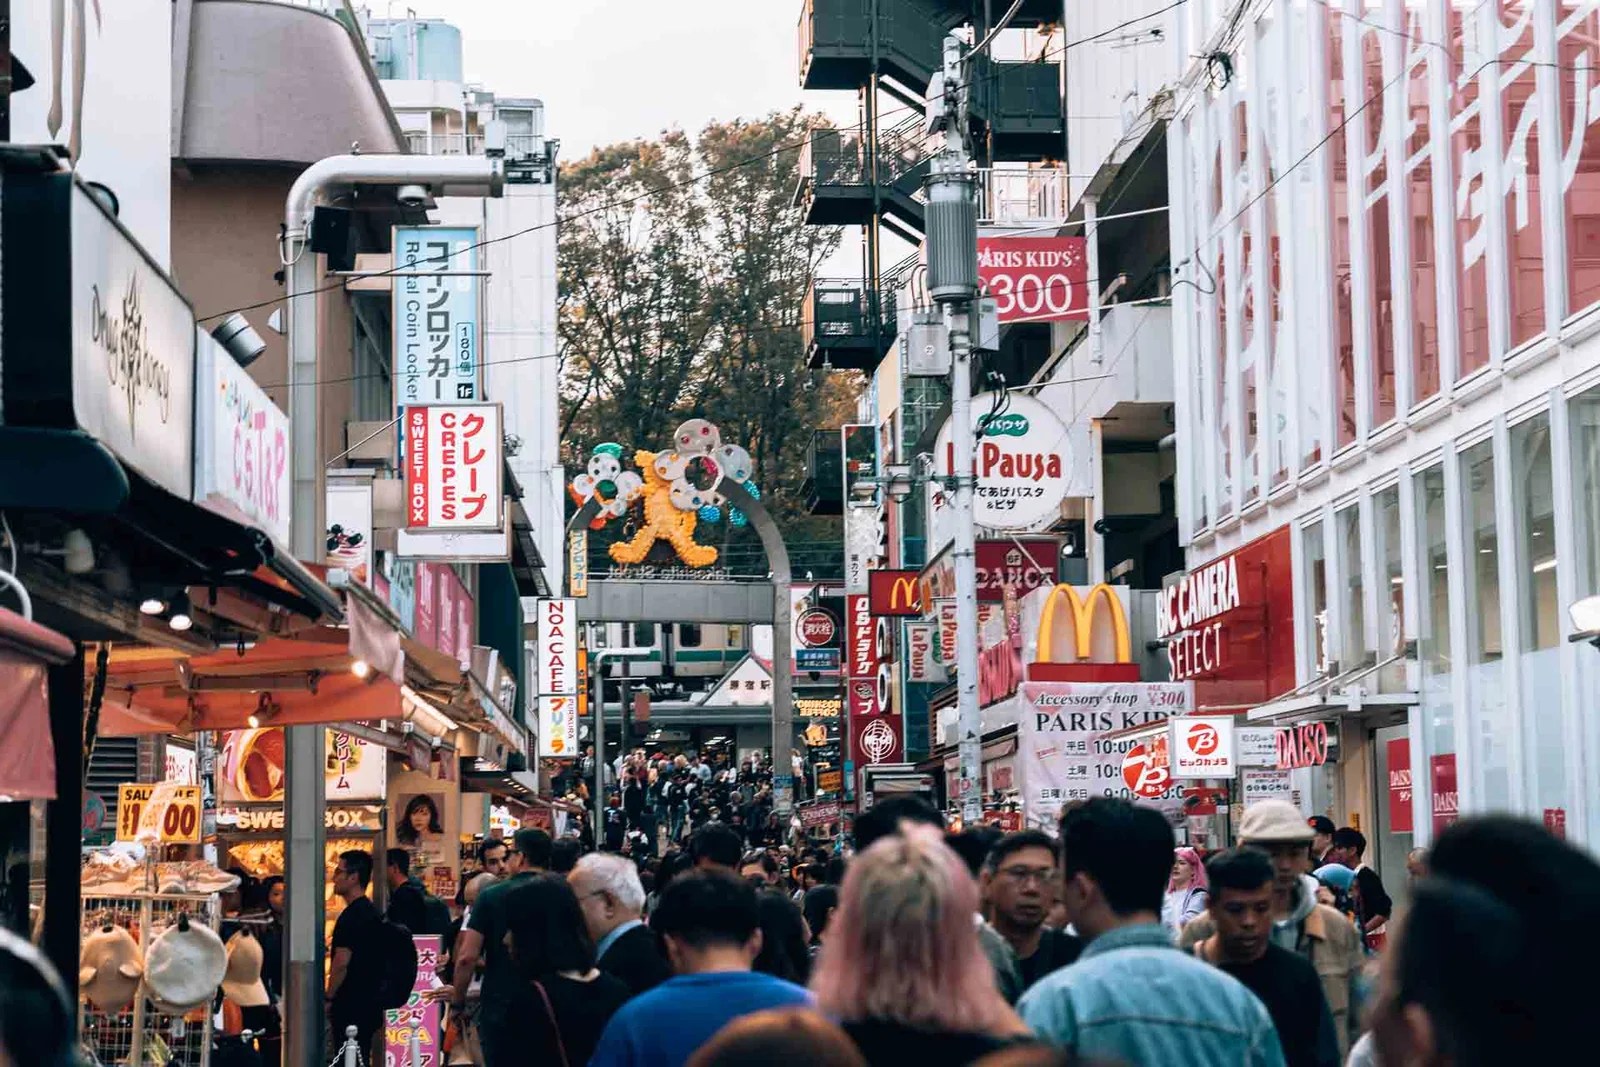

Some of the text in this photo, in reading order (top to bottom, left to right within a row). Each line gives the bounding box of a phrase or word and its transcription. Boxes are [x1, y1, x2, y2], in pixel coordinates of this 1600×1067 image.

[1026, 250, 1073, 268] KID'S
[405, 299, 421, 338] Coin
[426, 241, 450, 400] コインロッカー
[405, 343, 421, 401] Locker
[457, 385, 473, 398] 1F
[411, 413, 425, 522] SWEET BOX
[440, 412, 457, 520] CREPES
[461, 412, 488, 520] クレープ
[982, 442, 1062, 482] Pausa
[975, 486, 1045, 498] であげパスタ
[1156, 554, 1240, 639] BIC CAMERA
[548, 601, 565, 693] NOA CAFE
[1167, 621, 1222, 682] SELECT
[1034, 691, 1103, 708] Accessory
[1106, 691, 1139, 708] shop
[549, 697, 568, 754] プリクラ
[1035, 711, 1114, 732] PARIS
[1180, 757, 1228, 767] ビックカメラ
[1275, 721, 1328, 770] DAISO
[125, 789, 152, 801] SAL
[122, 802, 197, 837] ¥100
[235, 811, 285, 829] SWE
